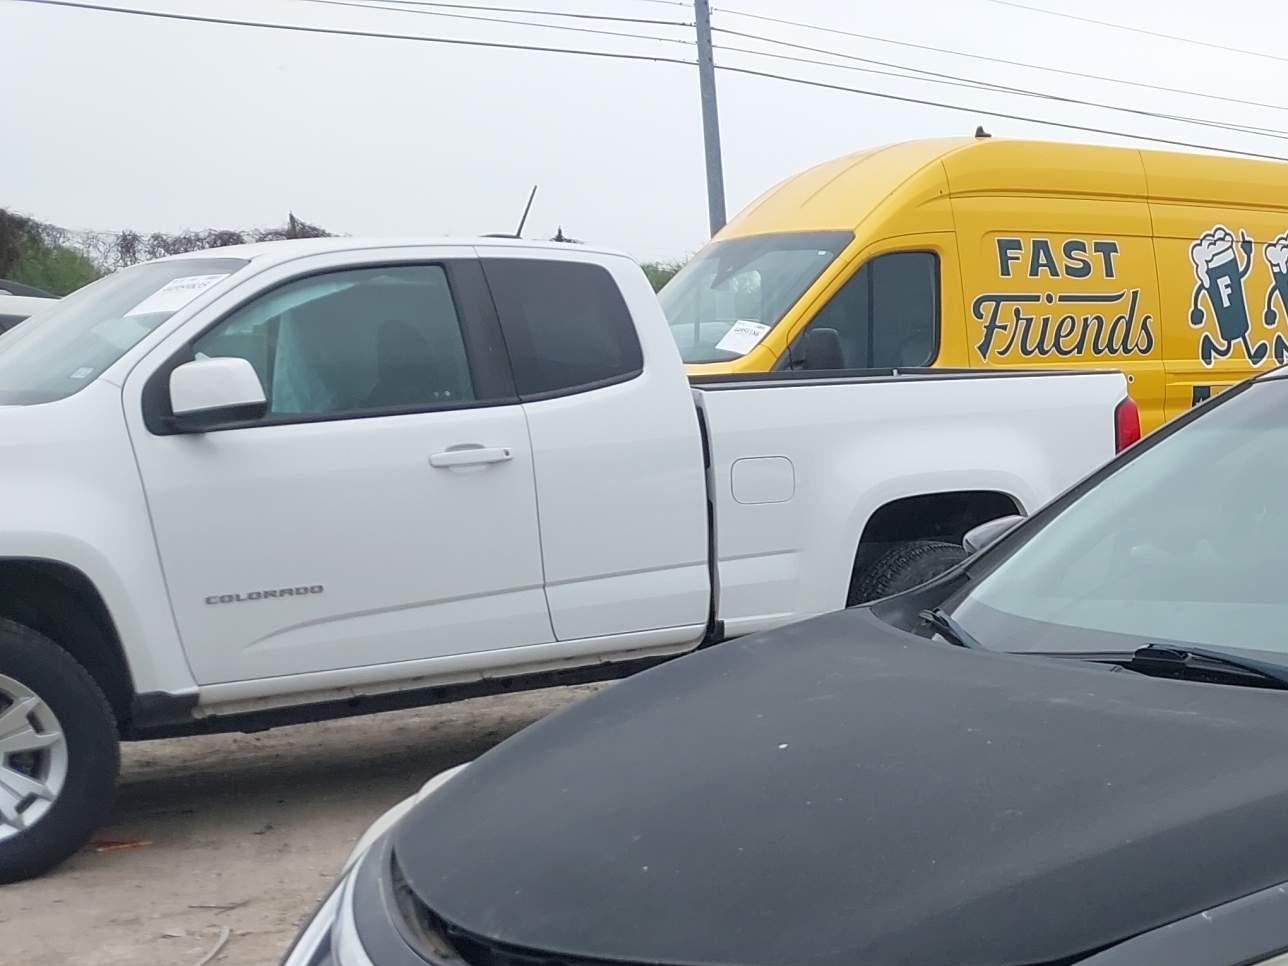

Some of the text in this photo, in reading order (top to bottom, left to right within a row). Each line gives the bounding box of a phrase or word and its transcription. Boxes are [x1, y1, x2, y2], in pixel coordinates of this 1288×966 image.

[996, 237, 1119, 279] FAST
[1216, 275, 1232, 308] F
[972, 289, 1154, 361] Friends
[205, 585, 324, 605] COLORADO
